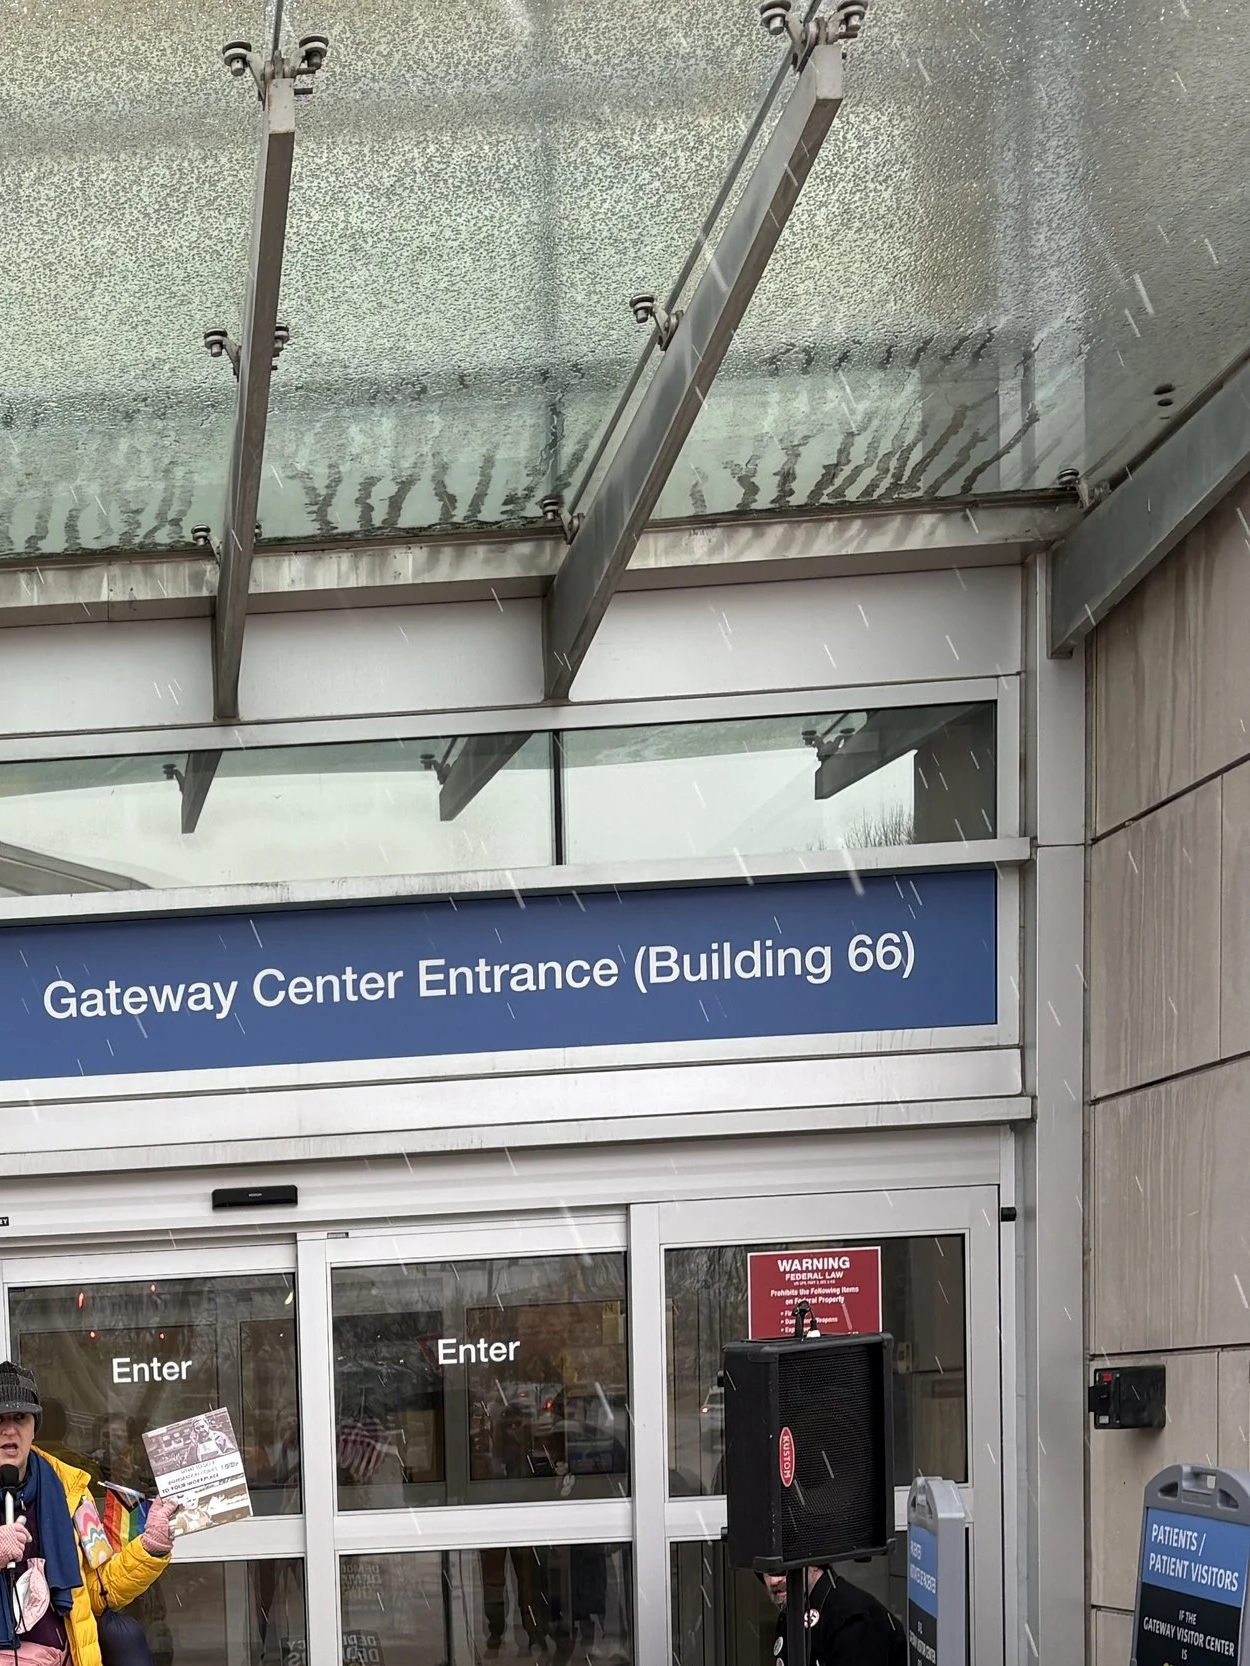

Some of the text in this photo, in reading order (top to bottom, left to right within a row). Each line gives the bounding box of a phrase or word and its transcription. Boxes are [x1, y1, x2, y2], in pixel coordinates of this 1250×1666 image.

[43, 930, 916, 1020] Gateway Center Entrance (Building 66)
[778, 1257, 850, 1272] WARNING
[785, 1271, 844, 1281] FEDERAL LAW
[437, 1337, 521, 1364] Enter
[111, 1356, 193, 1384] Enter
[783, 1435, 791, 1478] KUSTOM
[1151, 1524, 1198, 1551] PATIENTS
[1149, 1552, 1239, 1592] PATIENT VISITORS
[1179, 1609, 1197, 1625] IF THE
[1143, 1616, 1235, 1657] GATEWAY VISITOR CENTER
[1181, 1648, 1187, 1660] IS
